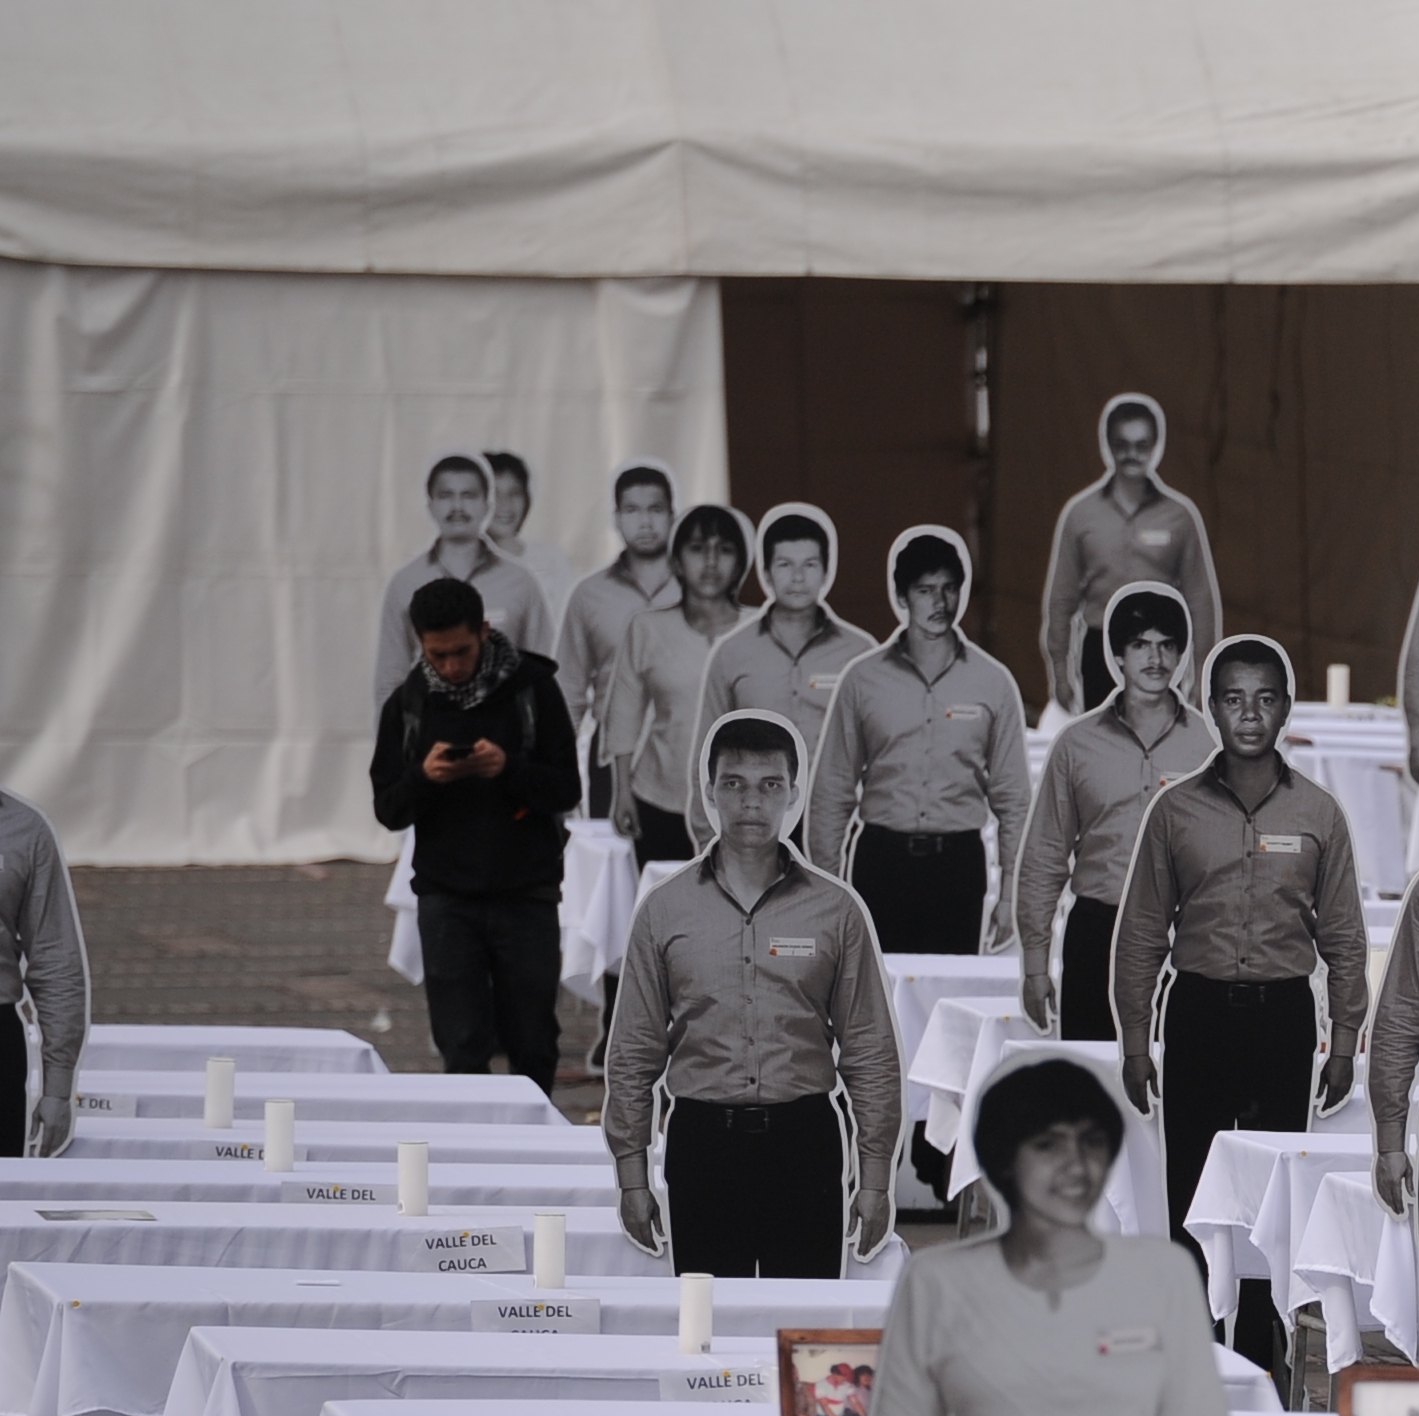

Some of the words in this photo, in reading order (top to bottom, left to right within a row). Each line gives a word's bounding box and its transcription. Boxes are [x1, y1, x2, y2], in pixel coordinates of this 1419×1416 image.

[89, 1097, 113, 1111] DEL
[215, 1146, 254, 1159] VALLE
[306, 1187, 347, 1200] VALLE
[351, 1188, 376, 1201] DEL
[425, 1235, 467, 1250] VALLE
[471, 1234, 497, 1248] DEL
[438, 1257, 487, 1272] CAUCA
[498, 1305, 541, 1319] VALLE
[545, 1305, 573, 1318] DEL
[687, 1375, 732, 1390] VALLE
[736, 1373, 764, 1387] DEL
